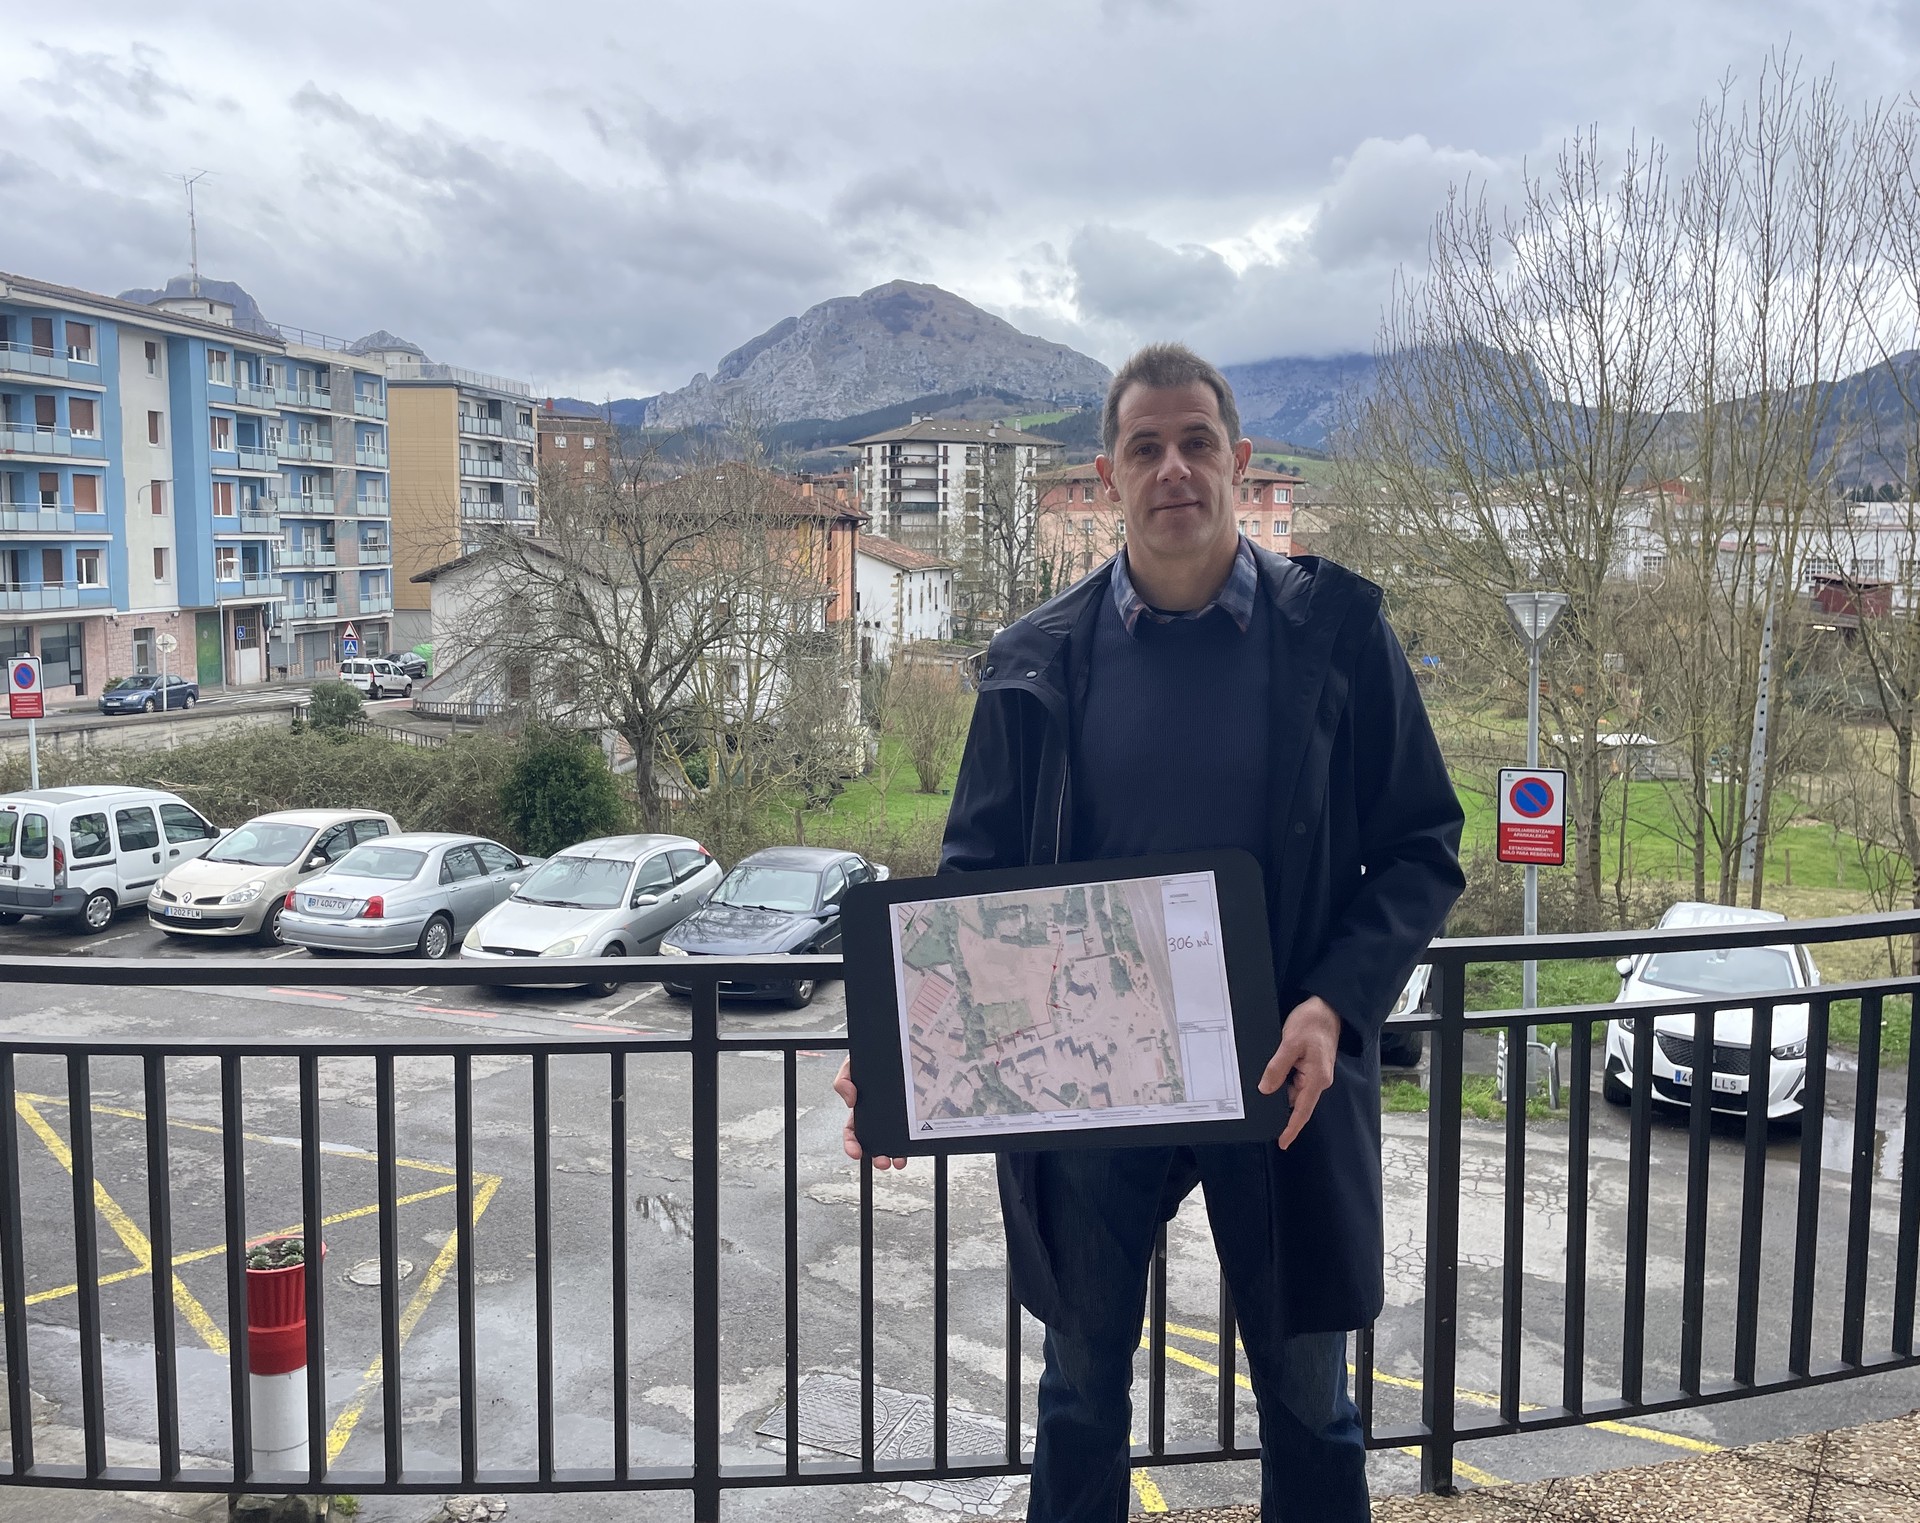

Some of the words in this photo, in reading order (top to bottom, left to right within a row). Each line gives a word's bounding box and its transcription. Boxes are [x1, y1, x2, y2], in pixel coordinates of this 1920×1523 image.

[170, 908, 186, 917] 1202
[1168, 935, 1194, 953] 306
[1714, 1078, 1737, 1091] LLS
